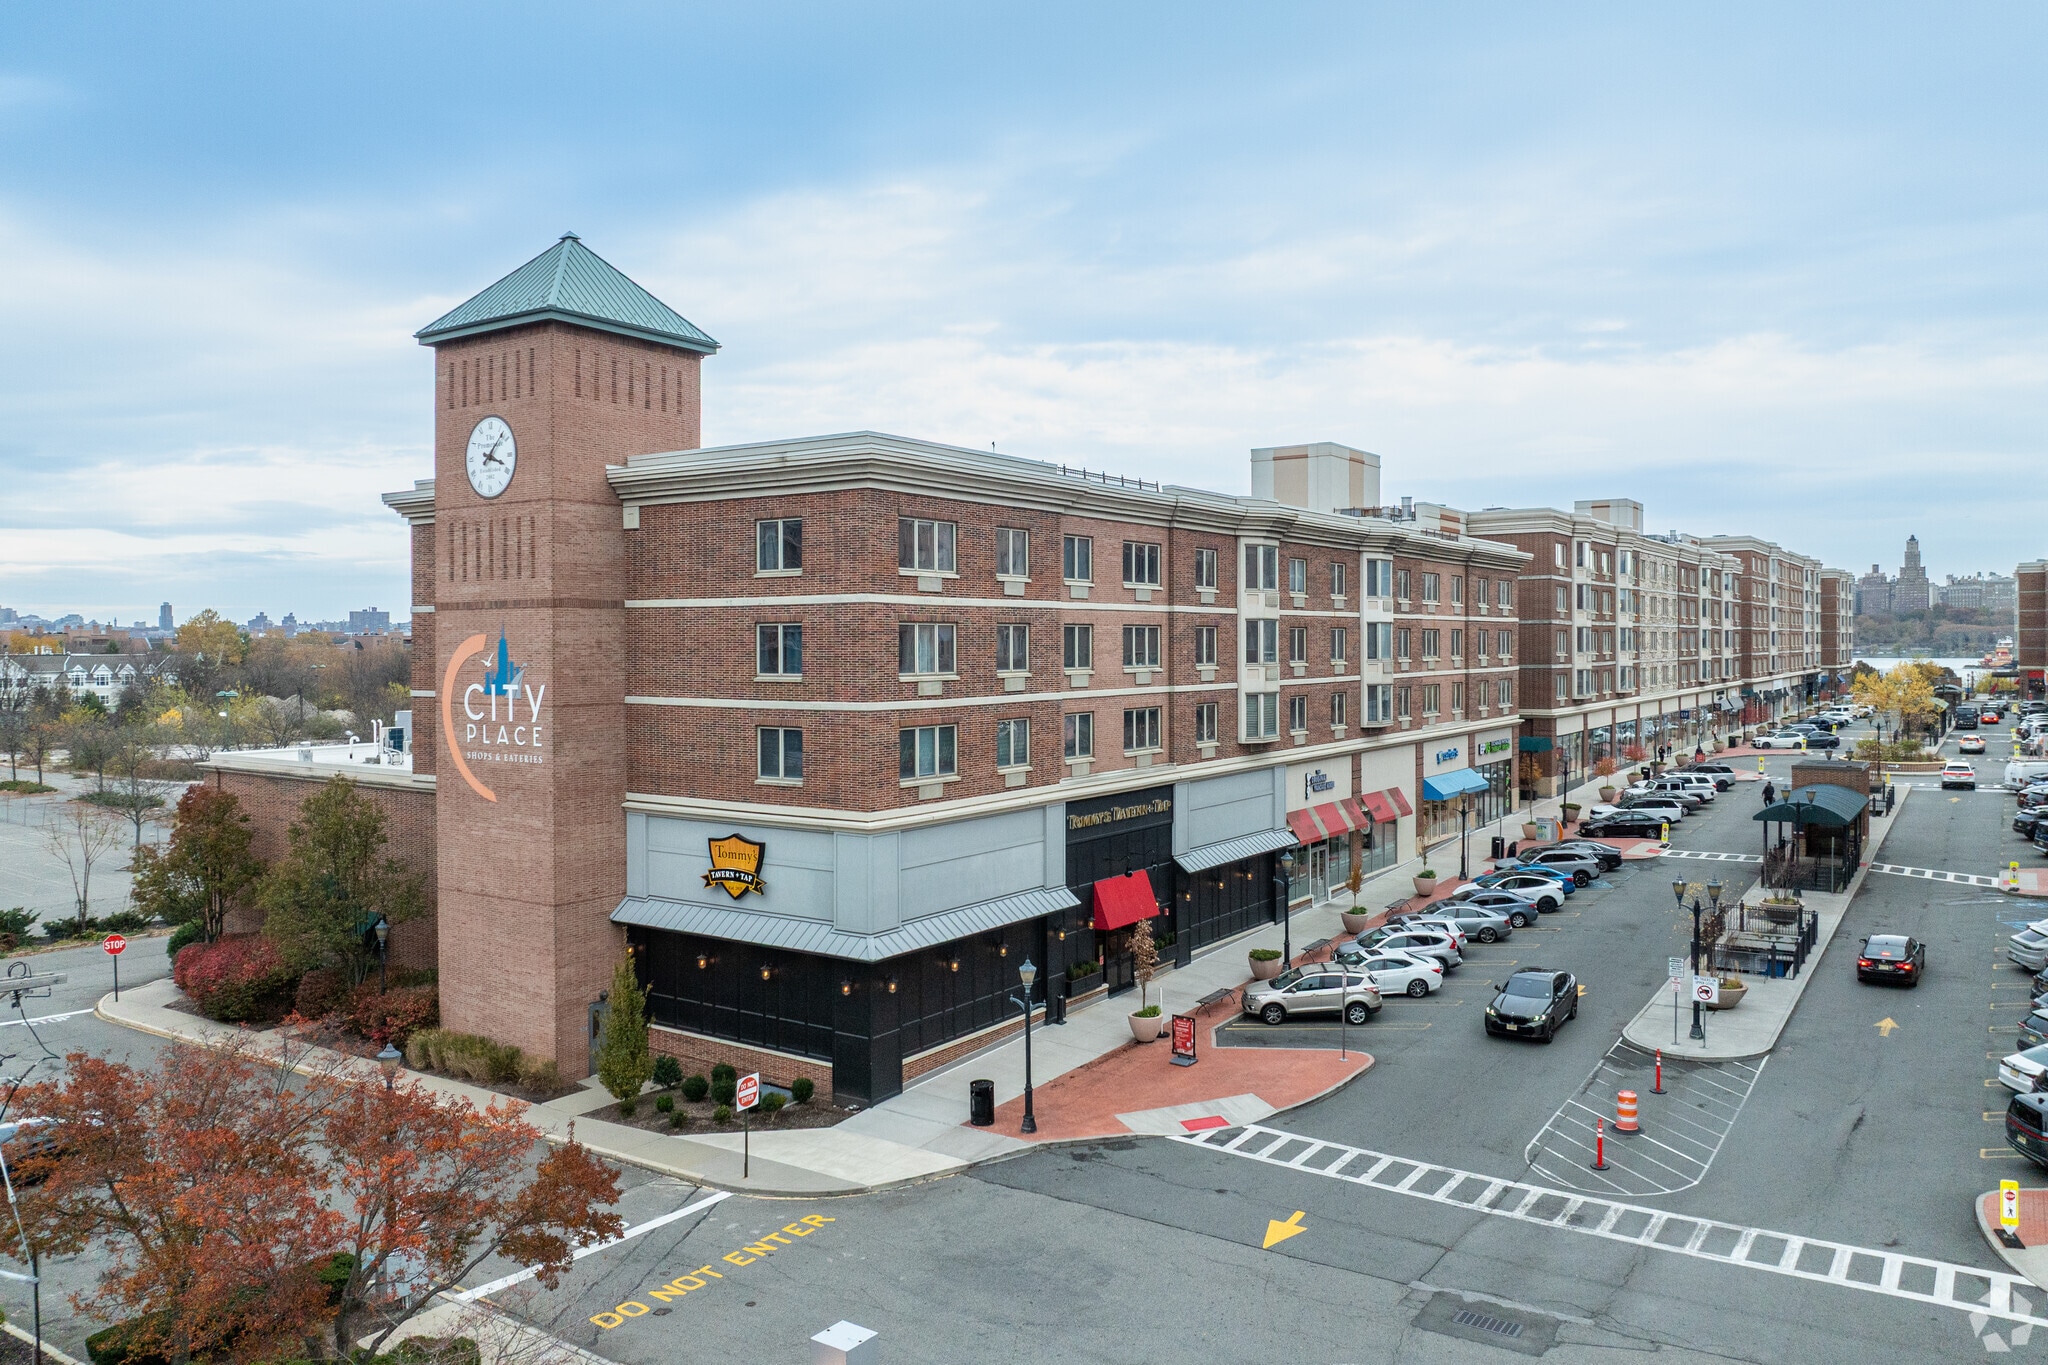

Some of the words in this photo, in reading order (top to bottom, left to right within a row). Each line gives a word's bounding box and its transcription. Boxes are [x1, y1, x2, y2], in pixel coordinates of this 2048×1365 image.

[464, 683, 546, 723] CITY
[466, 723, 543, 747] PLACE
[466, 751, 492, 760] SHOPS
[495, 753, 501, 761] &
[504, 753, 543, 764] EATERIES
[715, 844, 758, 865] Tommy's
[710, 870, 735, 879] TAVERN
[740, 873, 753, 882] TAP
[104, 940, 126, 950] STOP
[740, 1083, 747, 1091] DO
[741, 1094, 754, 1103] ENTER
[589, 1301, 650, 1329] DO
[648, 1265, 723, 1302] NOT
[722, 1214, 836, 1267] ENTER
